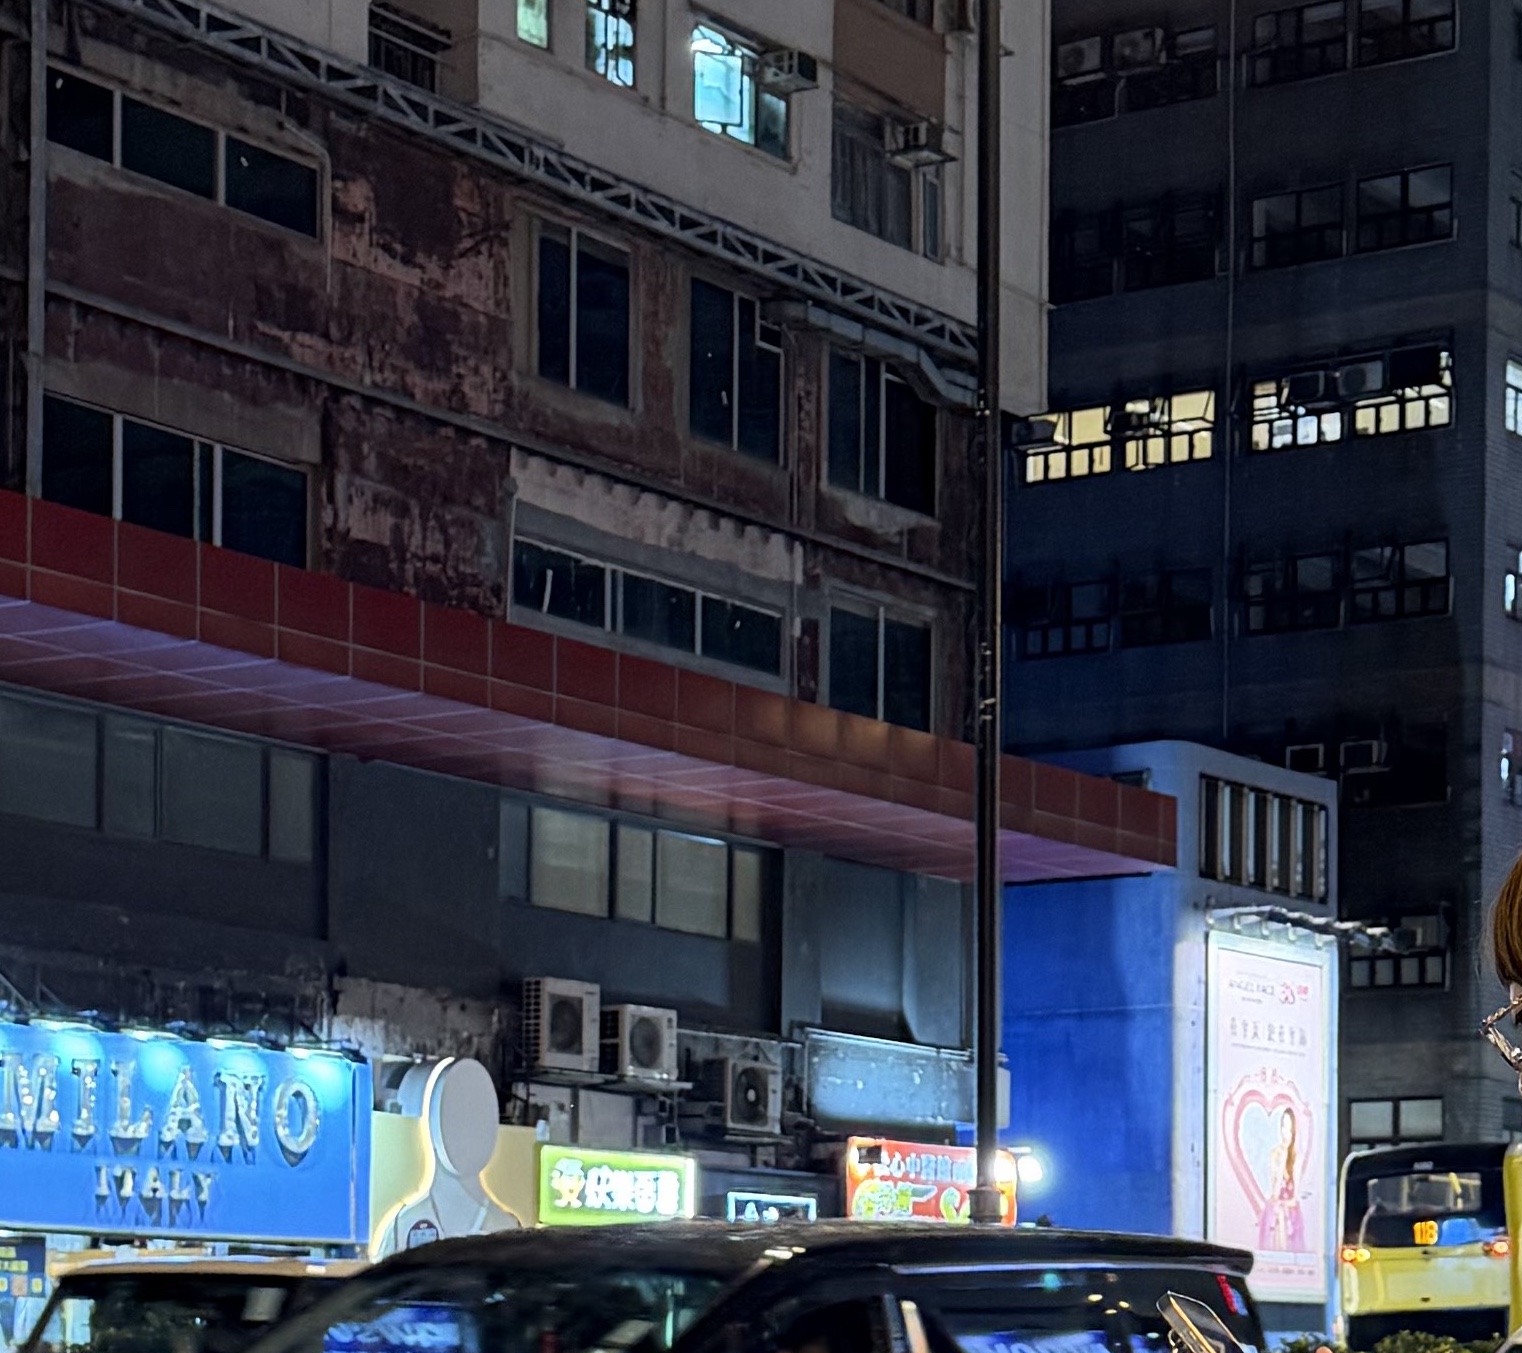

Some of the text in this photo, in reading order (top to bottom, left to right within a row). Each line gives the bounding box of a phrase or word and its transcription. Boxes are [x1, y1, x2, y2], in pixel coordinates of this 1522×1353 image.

[0, 1053, 320, 1157] MILANO
[95, 1164, 217, 1204] ITALY
[1413, 1220, 1438, 1245] 118
